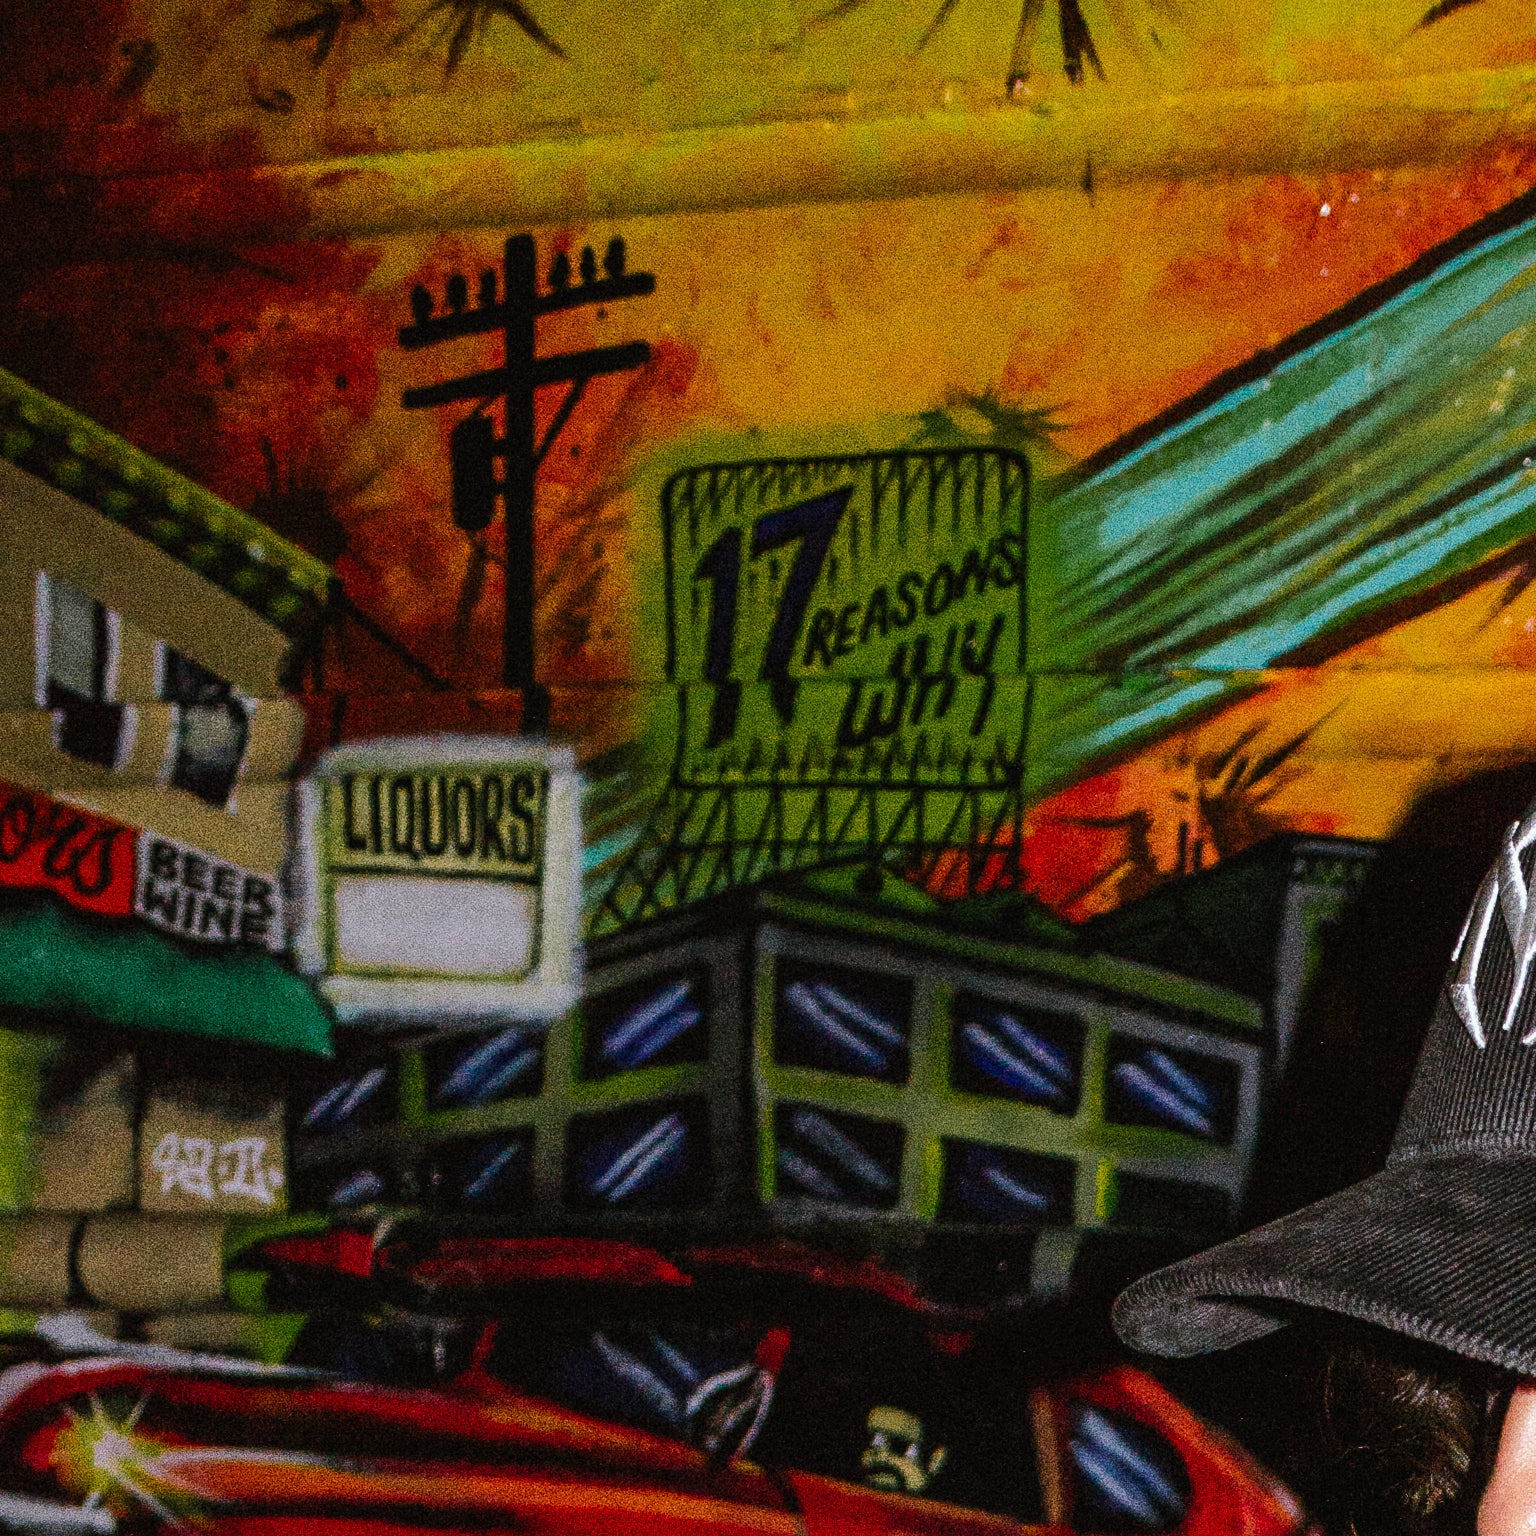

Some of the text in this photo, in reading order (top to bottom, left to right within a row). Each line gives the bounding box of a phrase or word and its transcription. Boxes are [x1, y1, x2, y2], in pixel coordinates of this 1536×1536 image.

[694, 484, 1023, 749] 17 REASONS
[838, 612, 1005, 748] WHY
[344, 771, 536, 863] LIQUORS
[143, 874, 272, 939] WINE
[149, 838, 273, 903] BEER
